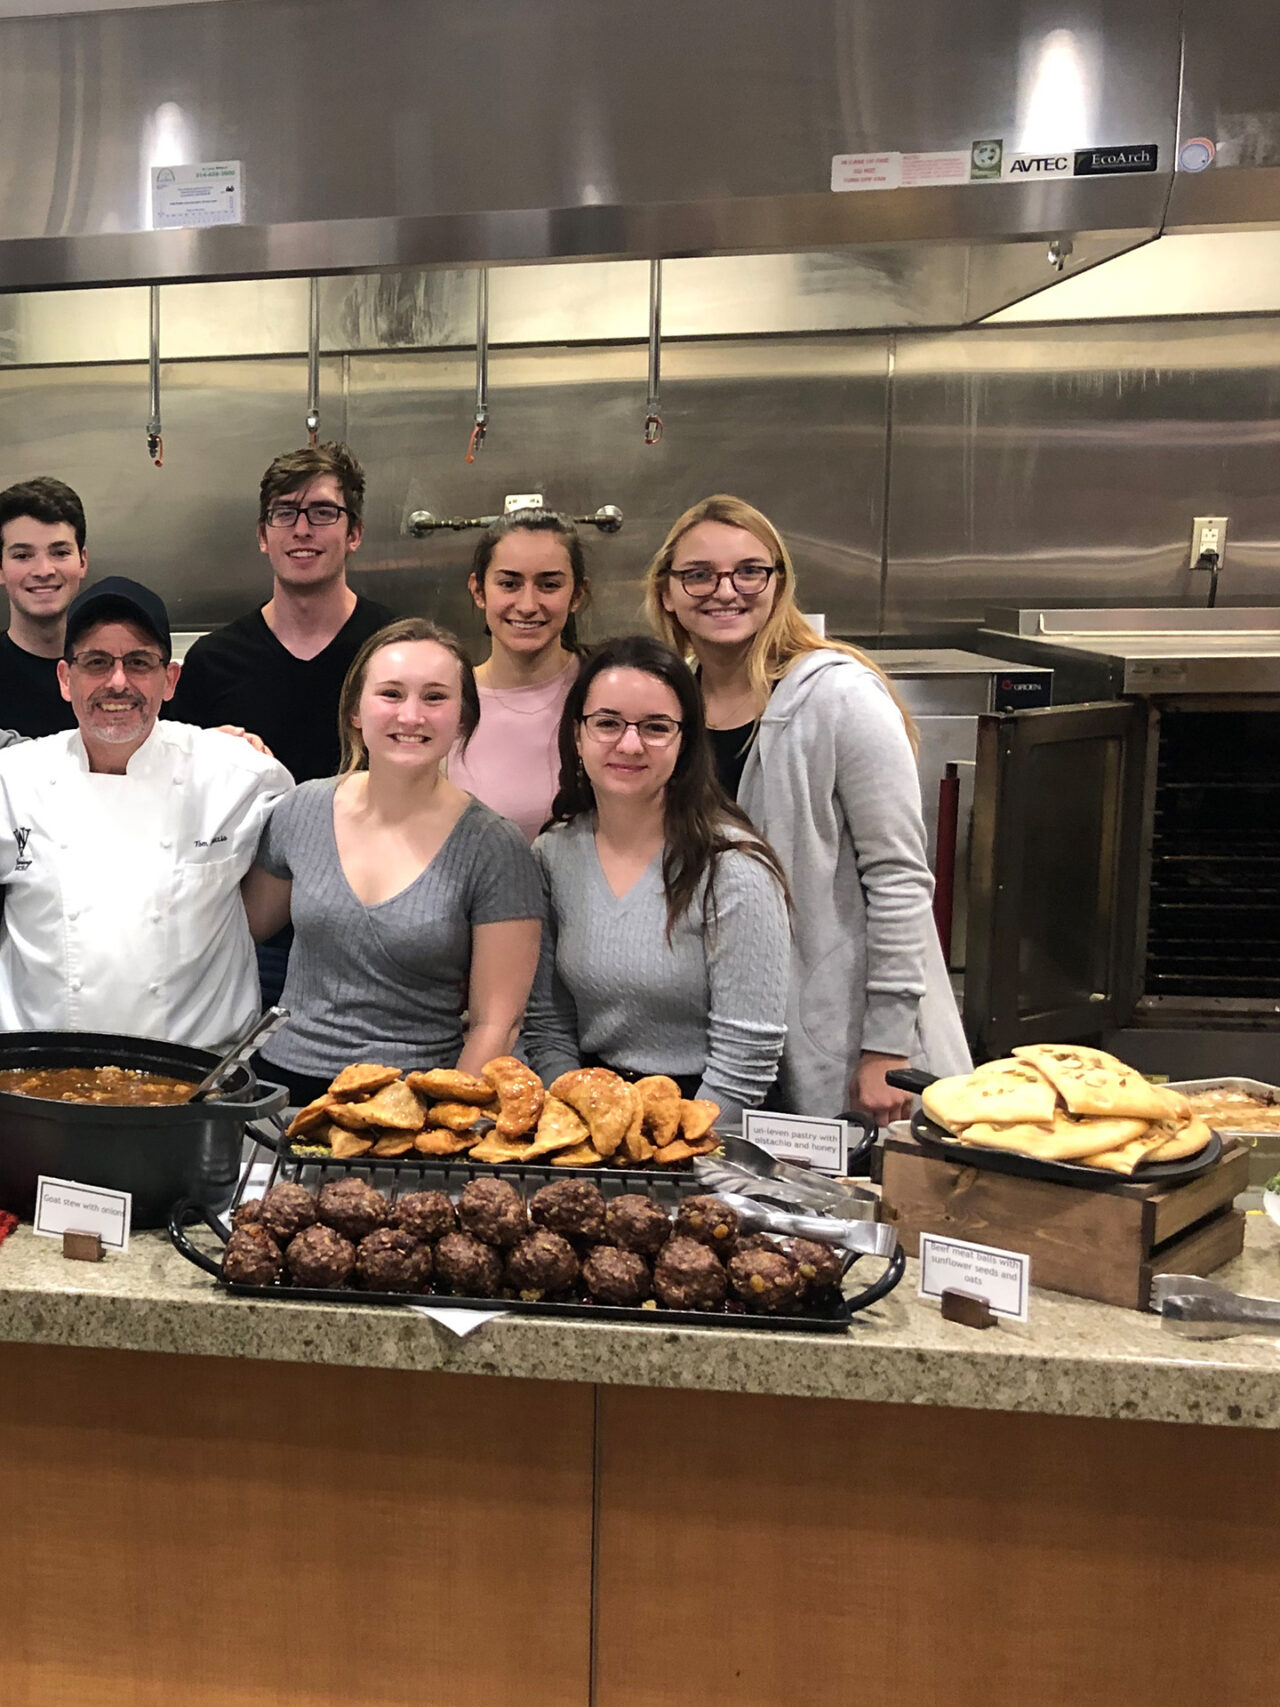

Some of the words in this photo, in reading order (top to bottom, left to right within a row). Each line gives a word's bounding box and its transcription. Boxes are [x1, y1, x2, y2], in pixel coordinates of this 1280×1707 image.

[1010, 157, 1067, 173] AVTEC
[1092, 151, 1150, 165] EcoArch
[753, 1127, 789, 1137] un-leven
[791, 1131, 817, 1141] pastry
[794, 1141, 809, 1149] and
[812, 1143, 837, 1154] honey
[44, 1194, 62, 1205] Goat
[63, 1199, 80, 1208] stew
[82, 1202, 99, 1212] with
[930, 1242, 950, 1253] Beef
[952, 1248, 974, 1259] meat
[976, 1252, 997, 1264] balls
[999, 1258, 1018, 1269] with
[931, 1255, 972, 1270] sunflower
[974, 1264, 998, 1277] seeds
[1001, 1272, 1017, 1281] and
[964, 1275, 982, 1286] oats
